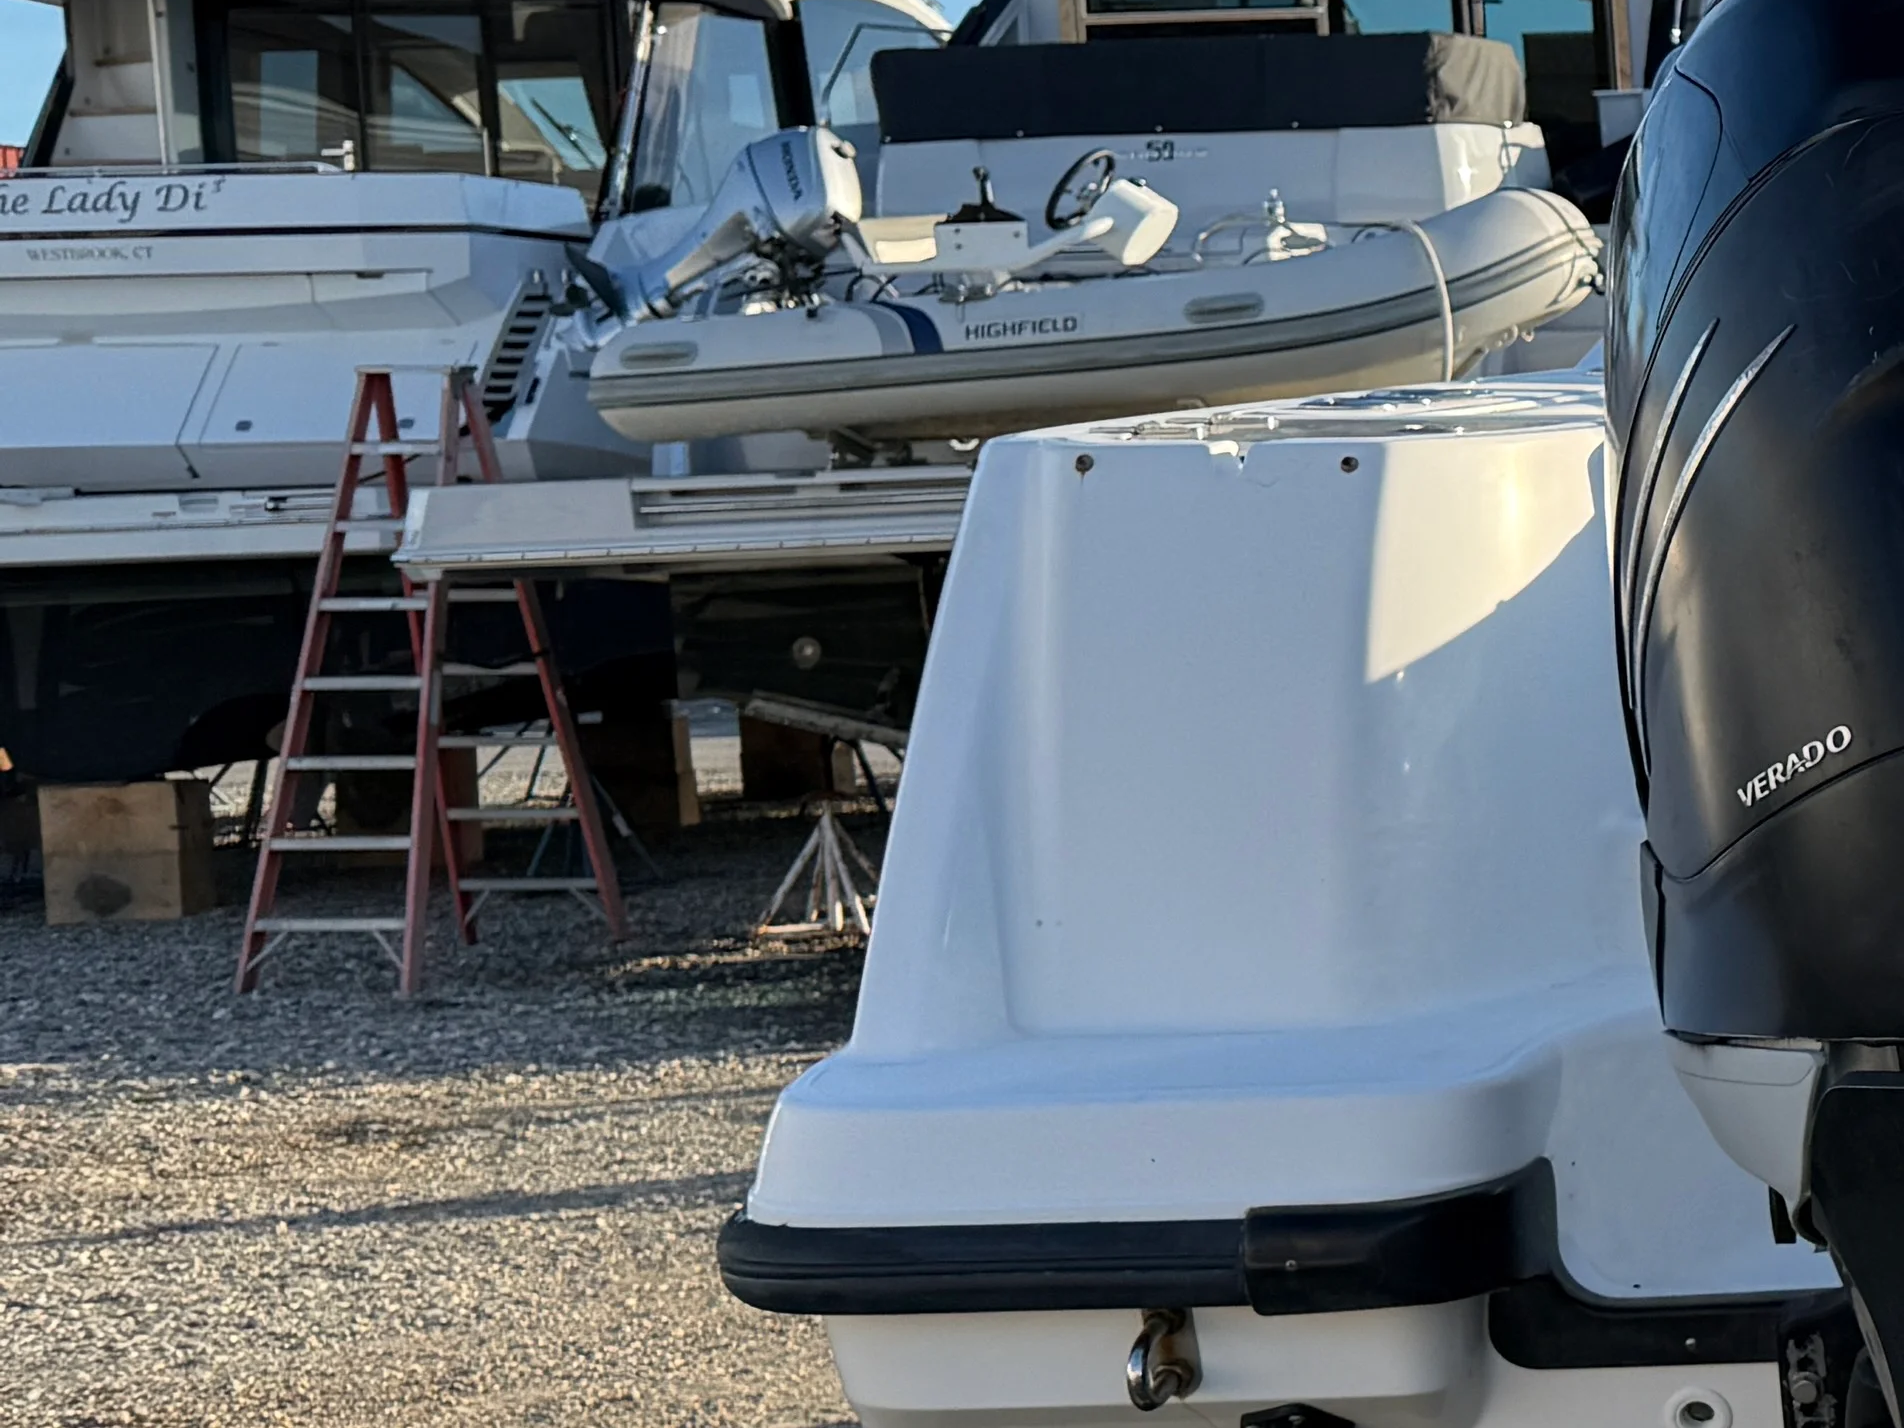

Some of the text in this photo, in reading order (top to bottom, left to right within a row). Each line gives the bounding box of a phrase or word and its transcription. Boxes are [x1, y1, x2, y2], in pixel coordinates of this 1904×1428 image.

[41, 180, 141, 223] Lady
[132, 245, 153, 260] CT
[965, 315, 1078, 340] HIGHFIELD
[1737, 725, 1852, 806] VERADO
